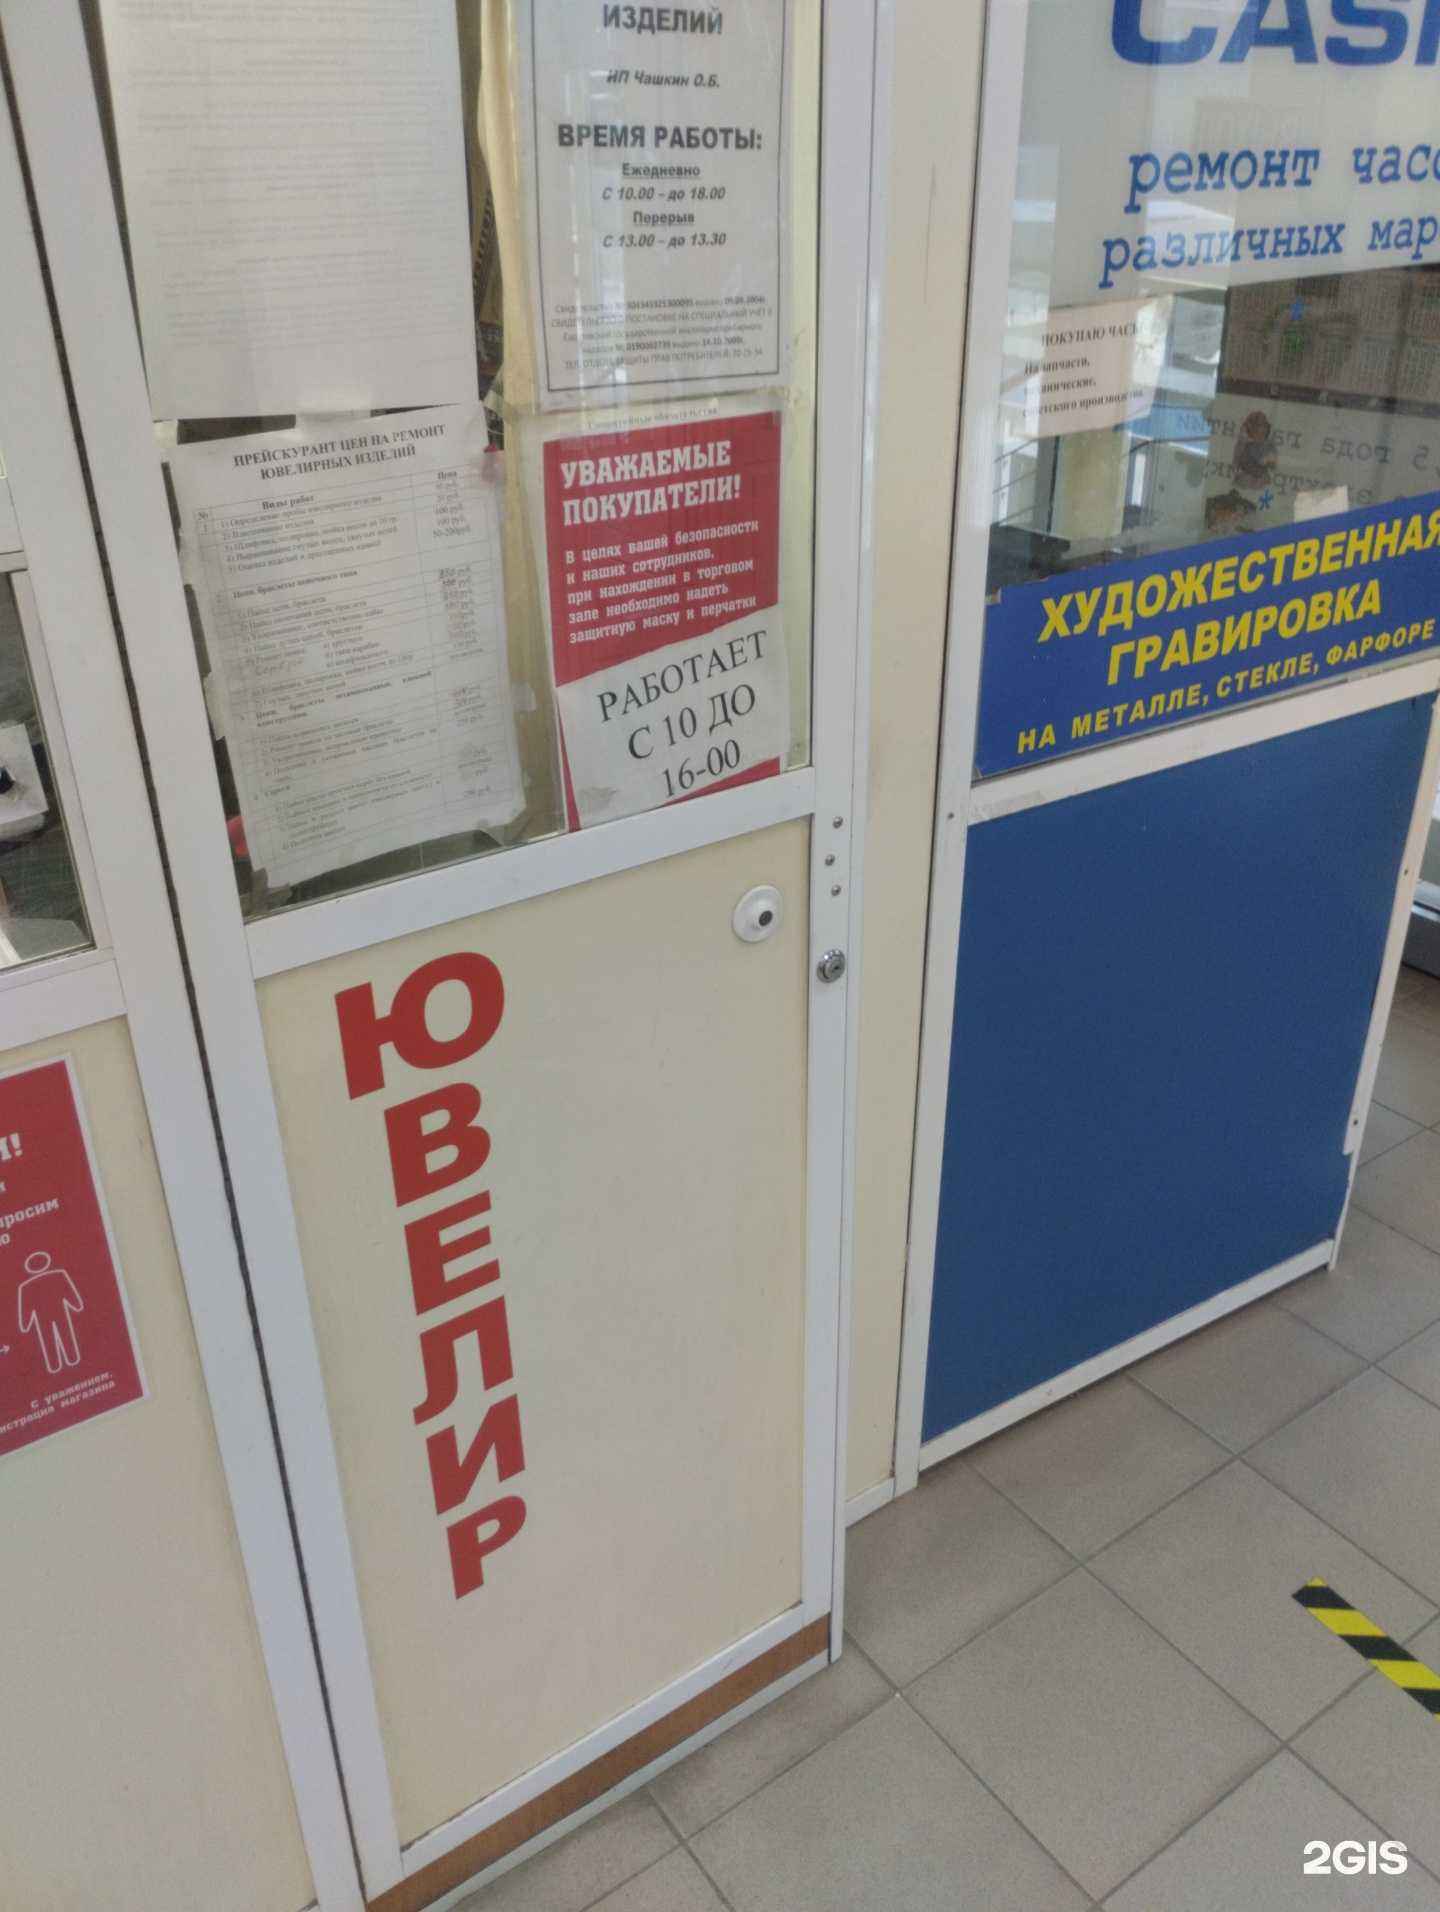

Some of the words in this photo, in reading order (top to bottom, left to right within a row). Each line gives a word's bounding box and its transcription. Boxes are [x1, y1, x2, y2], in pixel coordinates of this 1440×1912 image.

[603, 4, 723, 35] ИЗДЕЛИЙ
[635, 70, 689, 88] Чашкин
[694, 73, 720, 89] О.Б.
[557, 124, 645, 149] ВРЕМЯ
[654, 125, 762, 151] РАБОТЫ:
[617, 187, 655, 201] 10.00
[668, 189, 686, 202] до
[690, 186, 726, 200] 18.00
[622, 163, 700, 179] Ежедневно
[1124, 147, 1320, 213] ремонт
[617, 234, 655, 248] 13.00
[668, 237, 686, 249] до
[690, 233, 726, 247] 13.30
[633, 212, 695, 227] Перерыв
[1099, 223, 1346, 289] различных
[234, 441, 337, 468] ПРЕЙСКУРАНТ
[340, 437, 368, 452] ЦЕН
[371, 433, 390, 447] НА
[392, 424, 447, 443] РЕМОНТ
[260, 455, 352, 481] ЮВЕЛИРНЫХ
[355, 444, 416, 466] ИЗДЕЛИЙ
[561, 440, 731, 489] УВАЖАЕМЫЕ
[563, 474, 742, 526] ПОКУПАТЕЛИ!
[582, 544, 622, 563] целях
[629, 534, 669, 554] вашей
[675, 520, 759, 544] безопасности
[567, 573, 575, 585] и
[583, 564, 626, 582] наших
[568, 590, 592, 605] при
[600, 574, 677, 598] нахождении
[683, 571, 690, 583] в
[697, 559, 754, 581] торговом
[1037, 507, 1440, 644] ХУДОЖЕСТВЕННАЯ
[569, 608, 599, 624] зале
[606, 592, 680, 617] необходимо
[687, 584, 729, 601] надеть
[569, 621, 636, 645] защитную
[643, 612, 681, 630] маску
[687, 609, 695, 621] и
[701, 597, 757, 617] перчатки
[1107, 578, 1382, 686] ГРАВИРОВКА
[597, 630, 768, 723] РАБОТАЕТ
[1017, 724, 1057, 754] НА
[1072, 683, 1210, 740] МЕТАЛЛЕ,
[1216, 651, 1320, 699] СТЕКЛЕ,
[1325, 618, 1437, 667] ФАРФОРЕ
[628, 726, 655, 760] С
[663, 706, 698, 746] 10
[708, 684, 756, 734] ДО
[662, 739, 741, 798] 16-00
[334, 951, 527, 1600] ЮВЕЛИР
